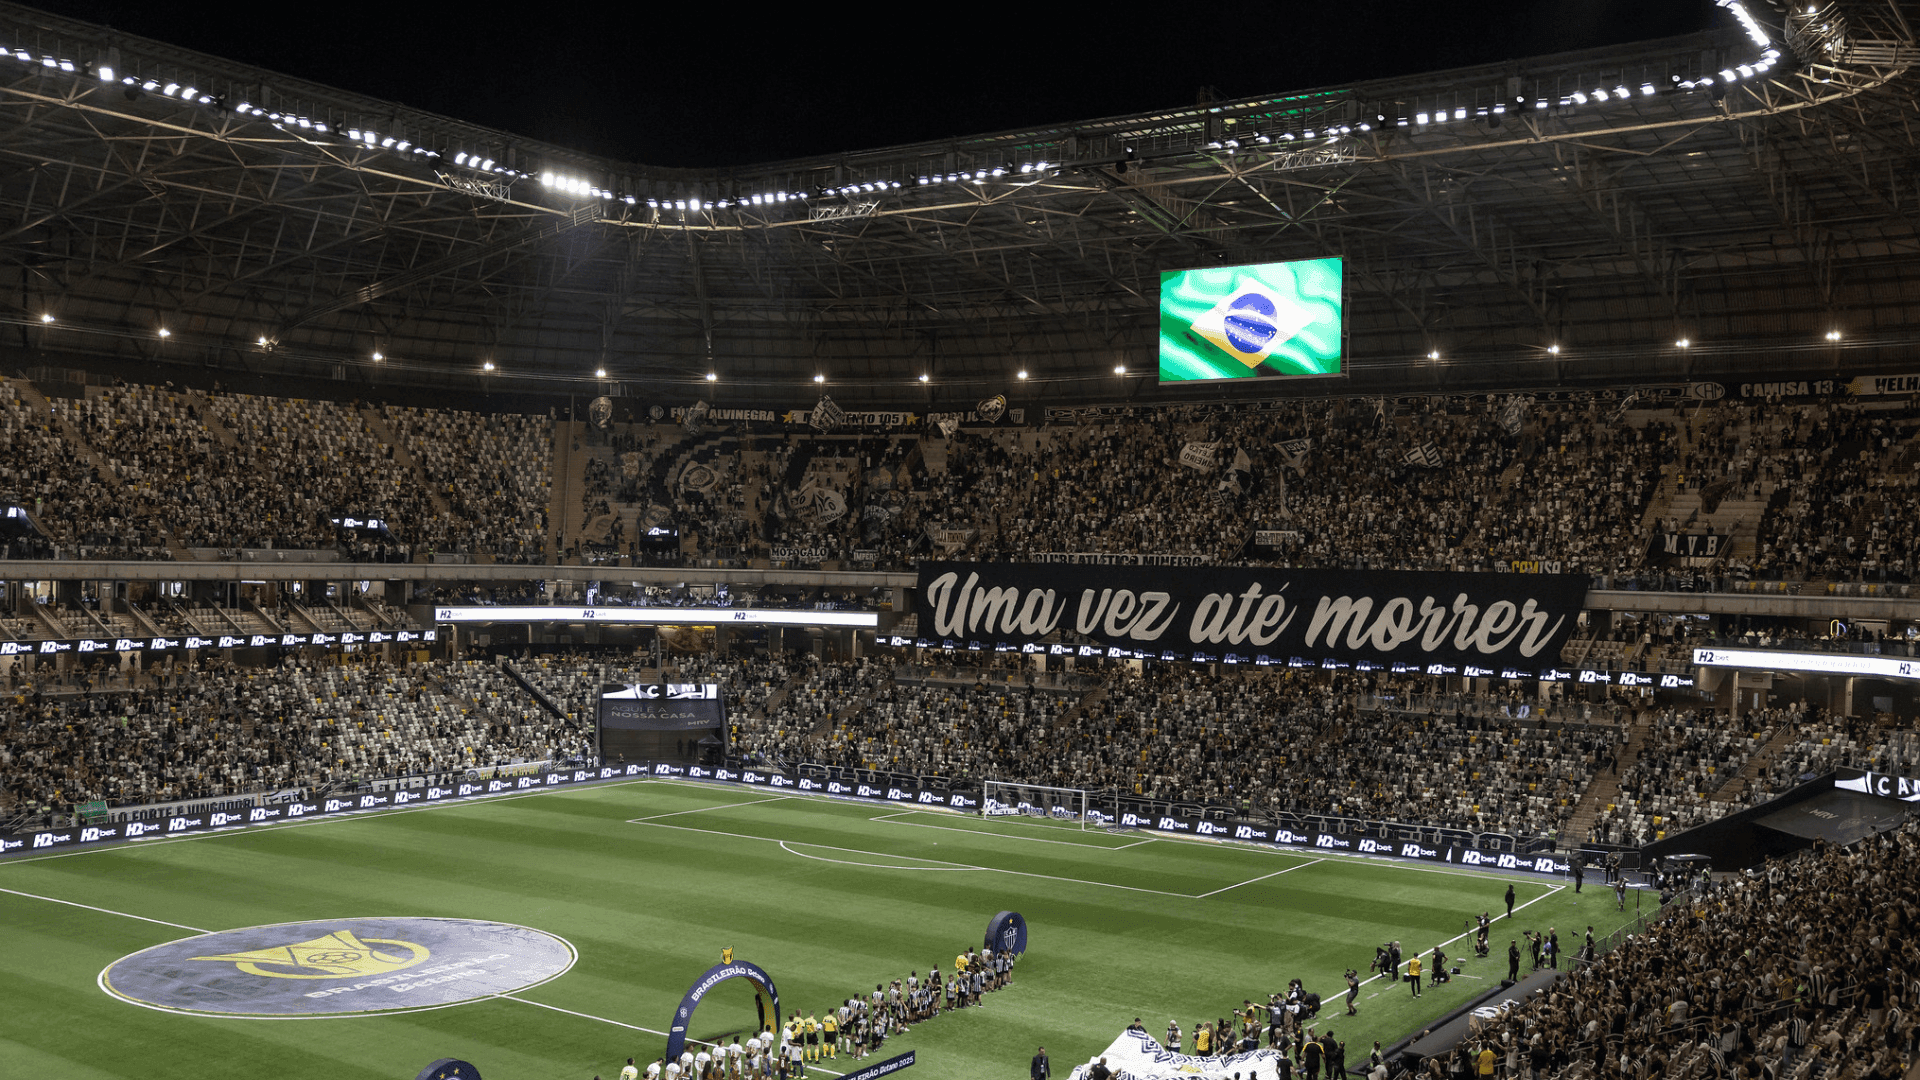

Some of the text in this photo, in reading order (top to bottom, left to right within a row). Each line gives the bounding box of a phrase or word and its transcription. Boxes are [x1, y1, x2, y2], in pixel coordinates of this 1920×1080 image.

[1740, 380, 1833, 397] CAMISA 13
[708, 409, 775, 421] ALVINEGRA
[878, 413, 899, 424] 105
[772, 547, 828, 558] MOTOGALO
[927, 571, 1566, 658] Uma vez até morrer
[611, 711, 656, 719] NOSSA
[691, 965, 746, 1002] BRASILEIRÃO
[899, 1056, 914, 1067] 2025
